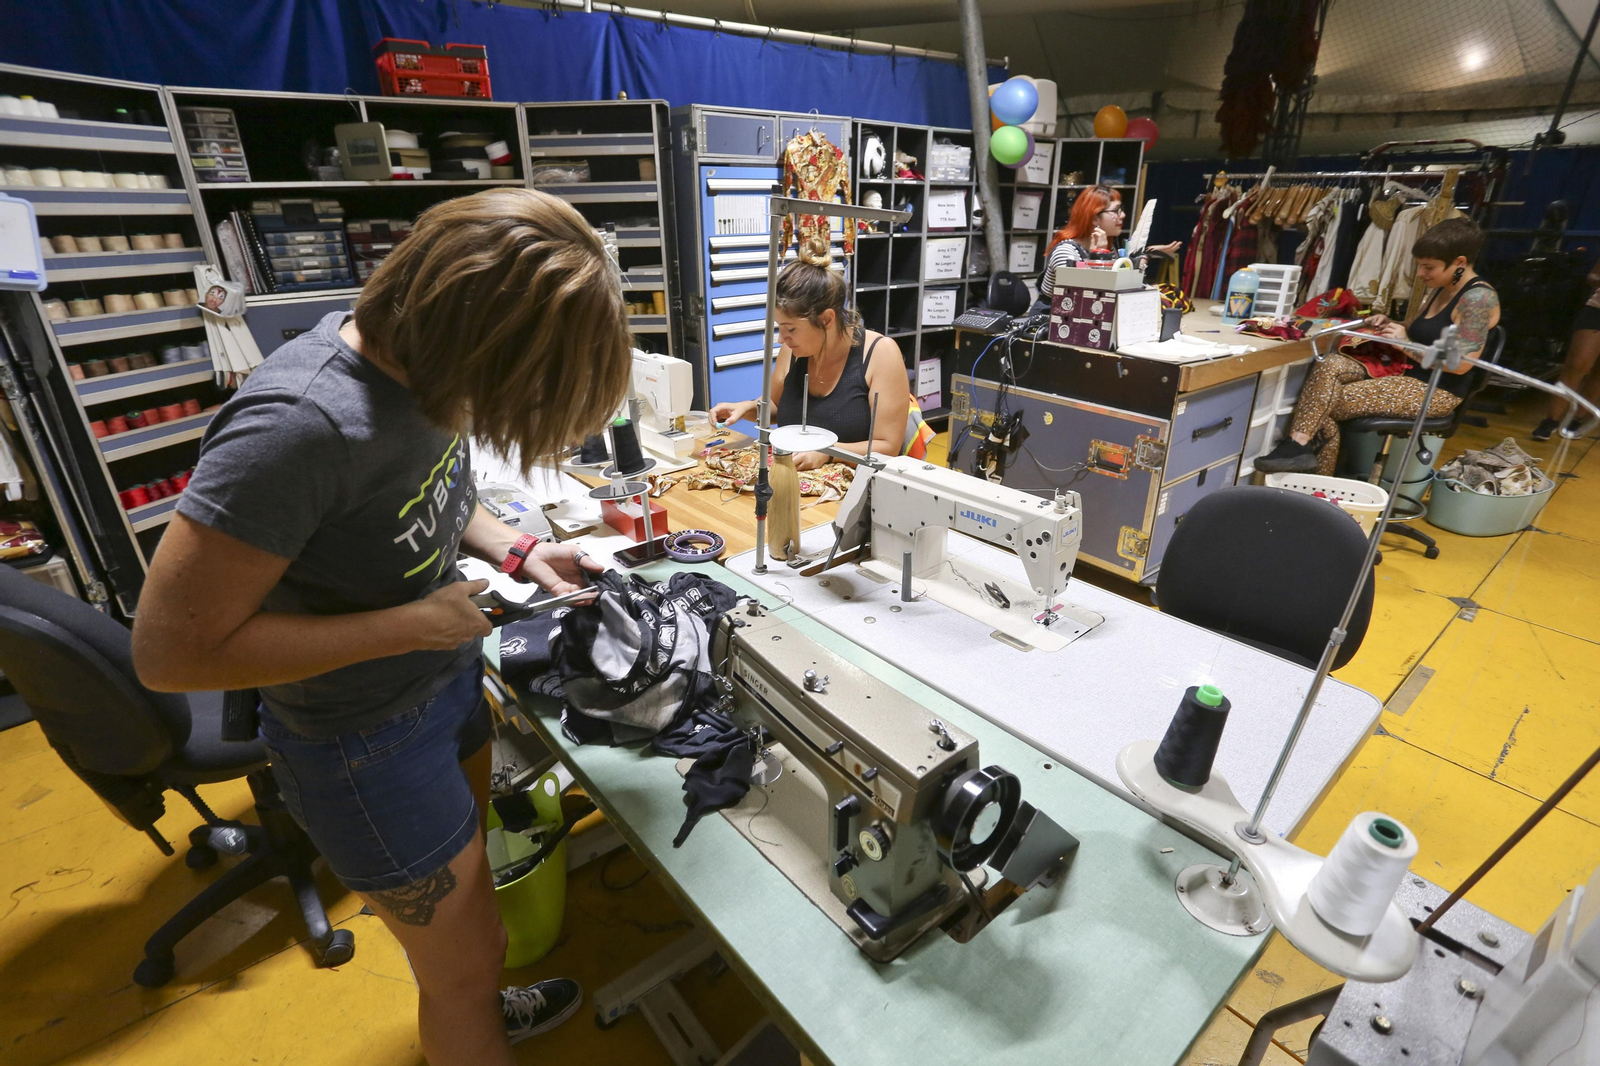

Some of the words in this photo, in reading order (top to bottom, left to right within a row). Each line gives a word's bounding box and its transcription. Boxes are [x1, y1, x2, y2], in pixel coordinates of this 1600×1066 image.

[960, 510, 997, 528] JUKI
[1062, 527, 1077, 538] JUKI
[743, 669, 769, 696] SINGER
